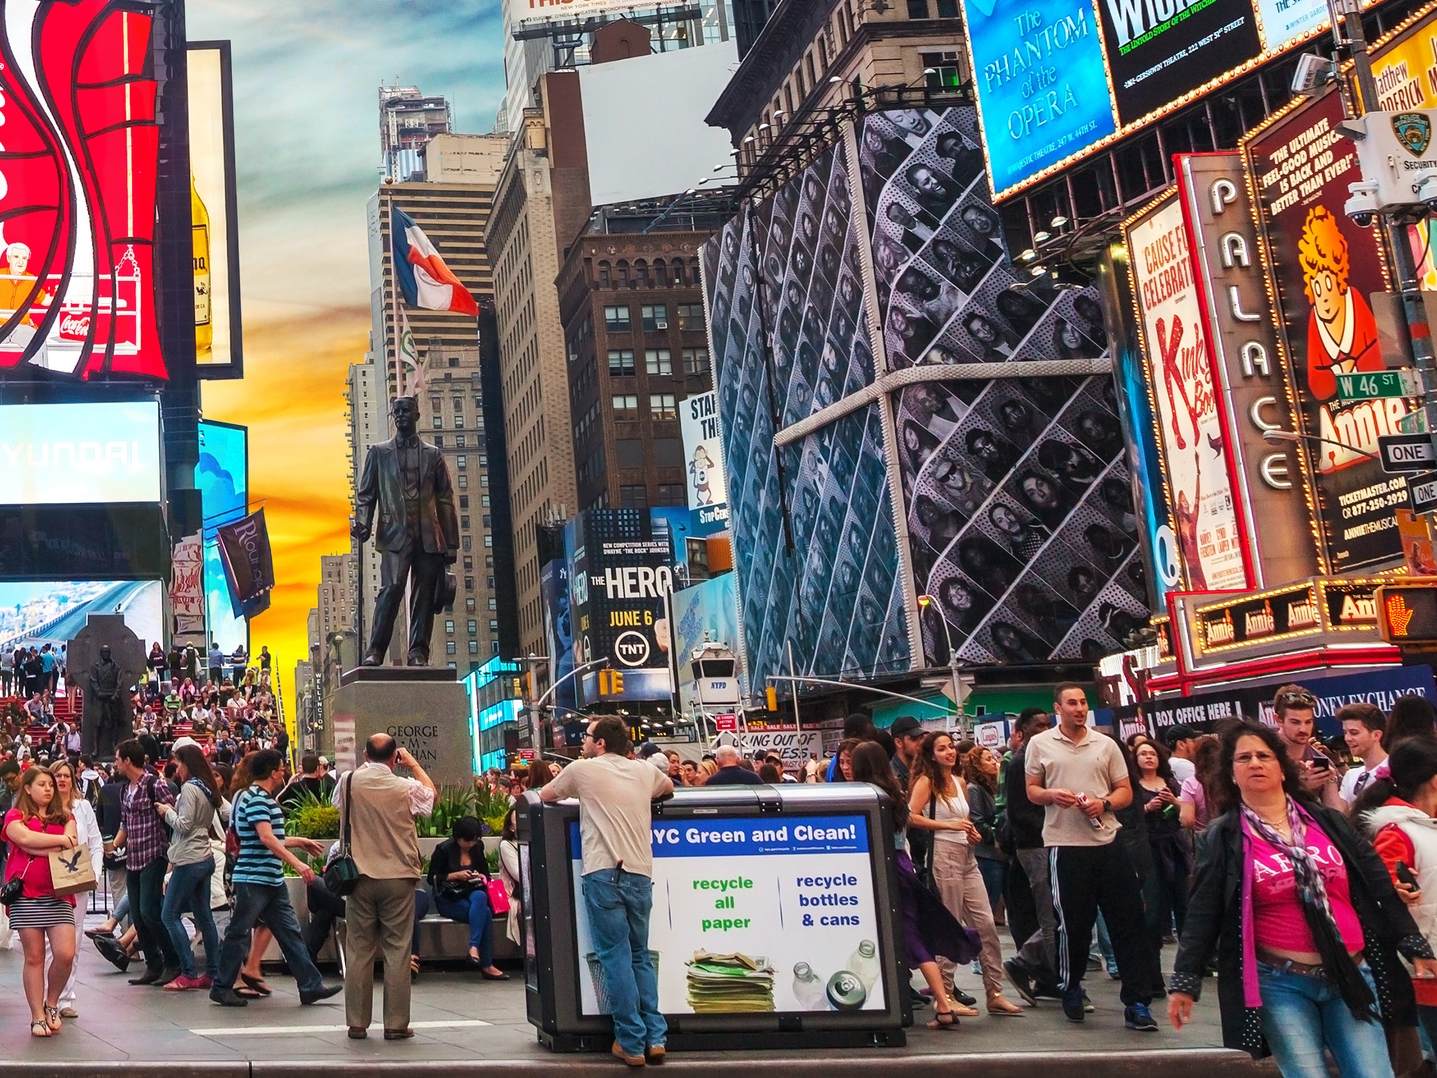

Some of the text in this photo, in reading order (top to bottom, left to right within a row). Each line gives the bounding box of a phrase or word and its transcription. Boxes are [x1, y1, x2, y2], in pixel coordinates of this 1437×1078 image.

[1014, 9, 1042, 38] The
[985, 7, 1089, 94] PHANTOM
[1021, 65, 1057, 100] of the
[1008, 83, 1078, 140] OPERA
[1289, 117, 1330, 154] ULTIMATE
[1279, 150, 1334, 194] IS BACK AND
[1404, 159, 1437, 170] SECURITY
[1270, 189, 1300, 216] BETTER
[1299, 173, 1325, 197] THAN
[1144, 228, 1175, 276] CAUSE
[1212, 178, 1292, 490] PALACE
[1340, 374, 1394, 397] W 46 ST
[1319, 398, 1407, 471] Annie
[1393, 445, 1425, 461] ONE
[1339, 476, 1407, 507] TICKETMASTER.COM
[1418, 484, 1436, 502] ONE
[1342, 490, 1408, 519] OR 877-250-2929
[591, 566, 673, 599] THE HERO
[610, 610, 653, 626] JUNE 6
[1246, 612, 1275, 637] Annie
[620, 644, 645, 655] TNT
[315, 673, 323, 730] WELLINGTON
[1155, 702, 1231, 726] BOX OFFICE HERE
[386, 725, 438, 738] GEORGE
[686, 828, 746, 844] Green
[752, 826, 788, 842] and
[794, 824, 857, 841] Clean!
[693, 876, 753, 892] recycle
[797, 873, 858, 888] recycle
[715, 896, 735, 909] all
[799, 893, 859, 907] bottles
[701, 916, 751, 932] paper
[802, 914, 860, 927] & cans
